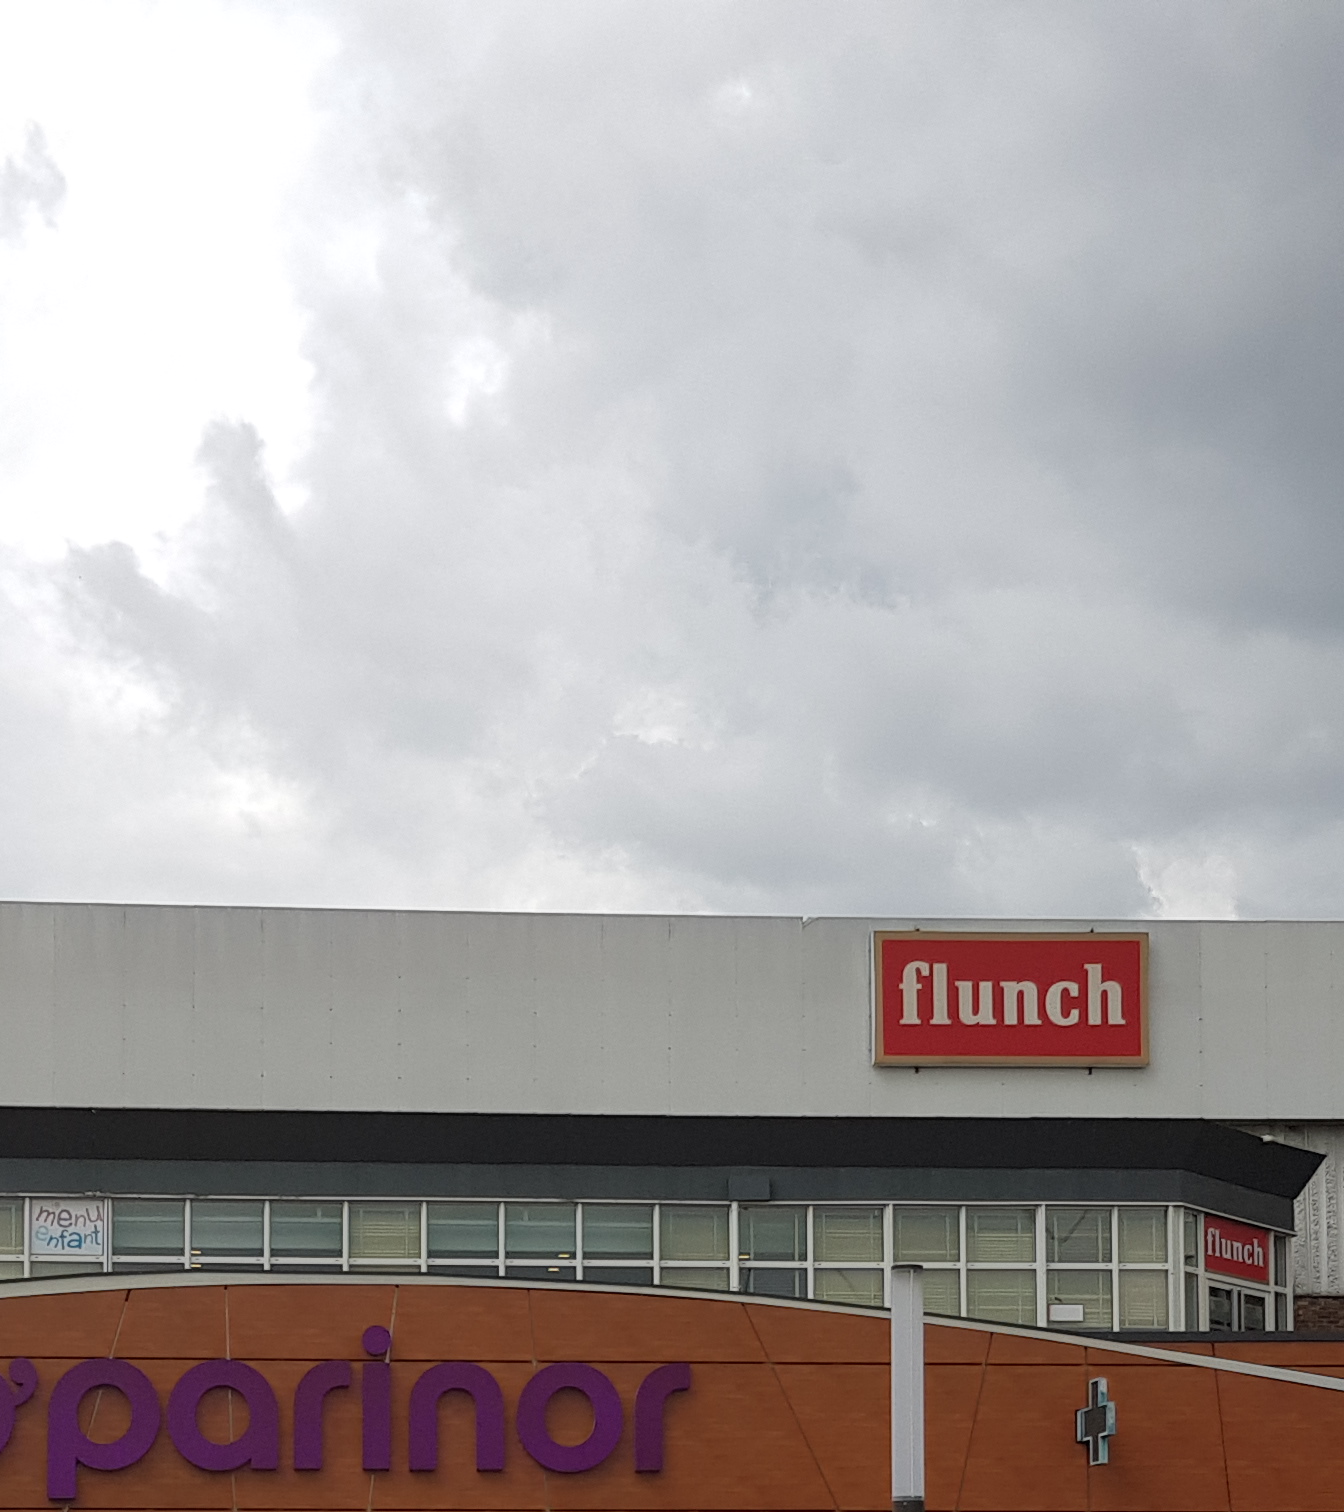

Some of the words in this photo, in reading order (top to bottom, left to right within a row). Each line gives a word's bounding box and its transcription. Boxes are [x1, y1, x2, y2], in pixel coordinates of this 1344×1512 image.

[898, 960, 1126, 1026] flunch
[36, 1205, 104, 1228] menu
[35, 1224, 102, 1250] enfant
[1206, 1227, 1265, 1267] flunch
